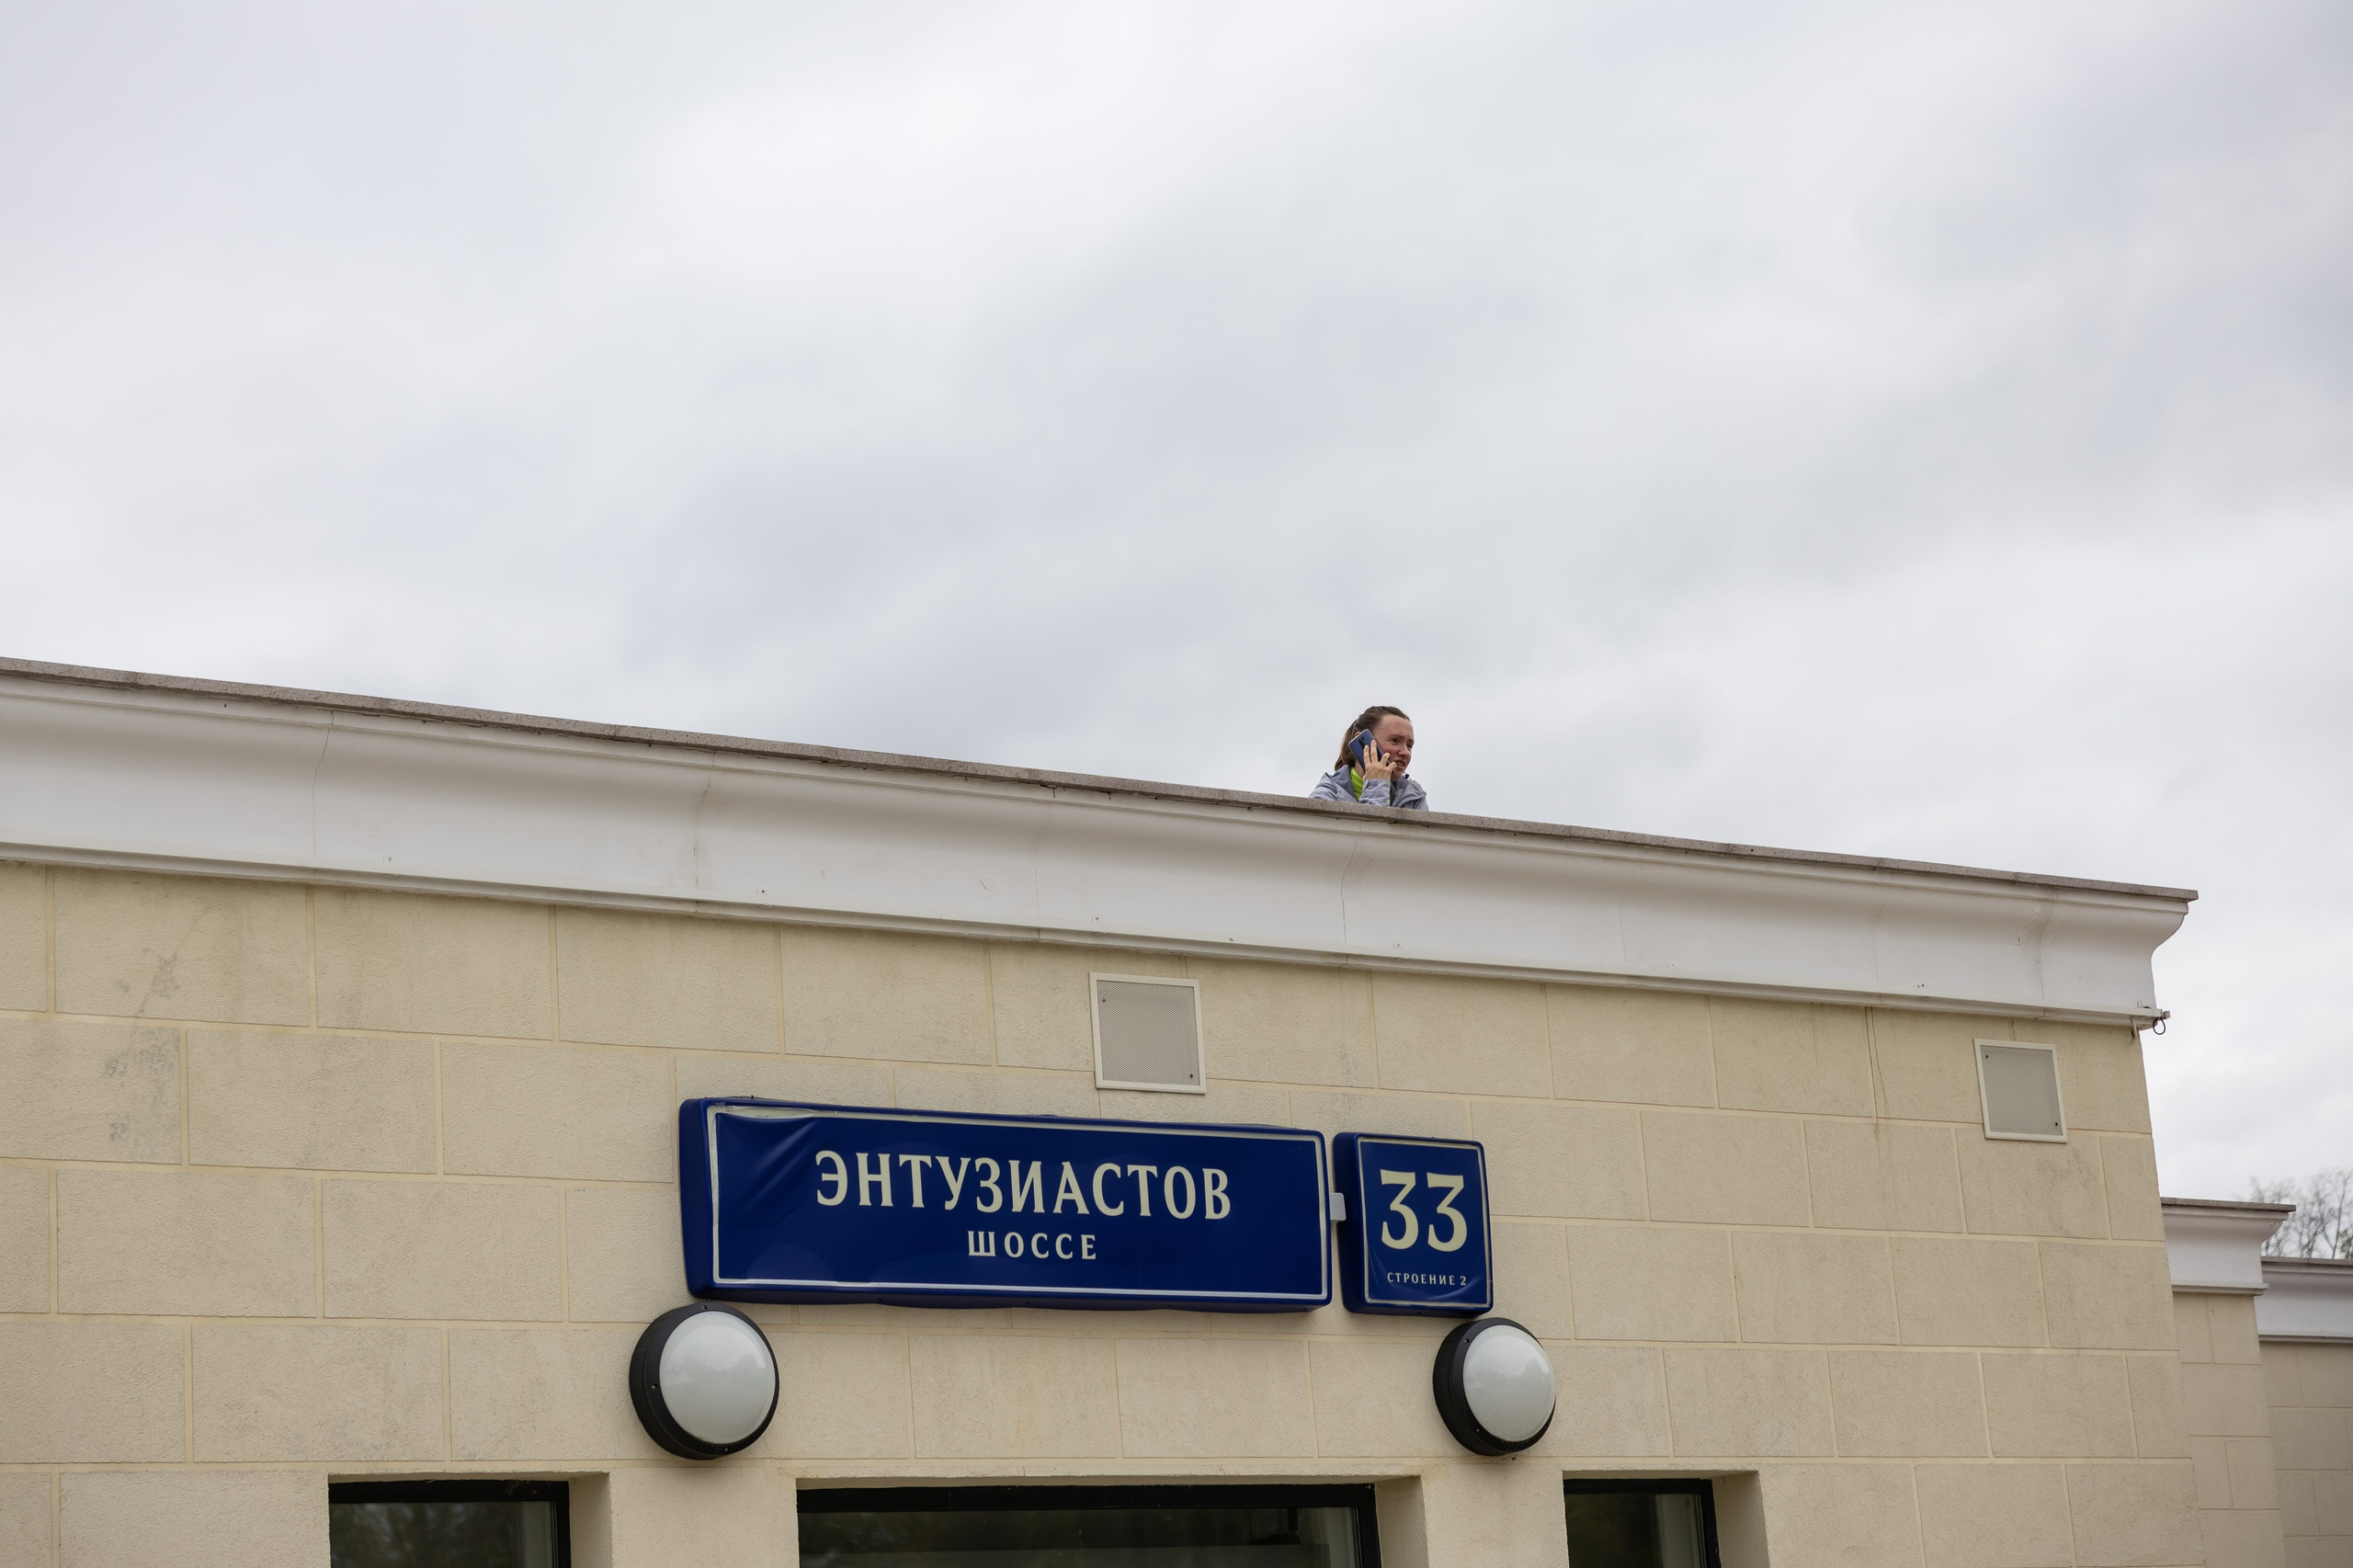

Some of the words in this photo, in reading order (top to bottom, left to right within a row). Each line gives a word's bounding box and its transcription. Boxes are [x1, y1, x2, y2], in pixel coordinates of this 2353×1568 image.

[814, 1149, 1232, 1221] ЭНТУЗИАСТОВ
[1380, 1168, 1468, 1253] 33
[967, 1230, 1098, 1261] ШОССЕ
[1387, 1271, 1455, 1286] СТРОЕНИЕ
[1460, 1275, 1468, 1286] 2
